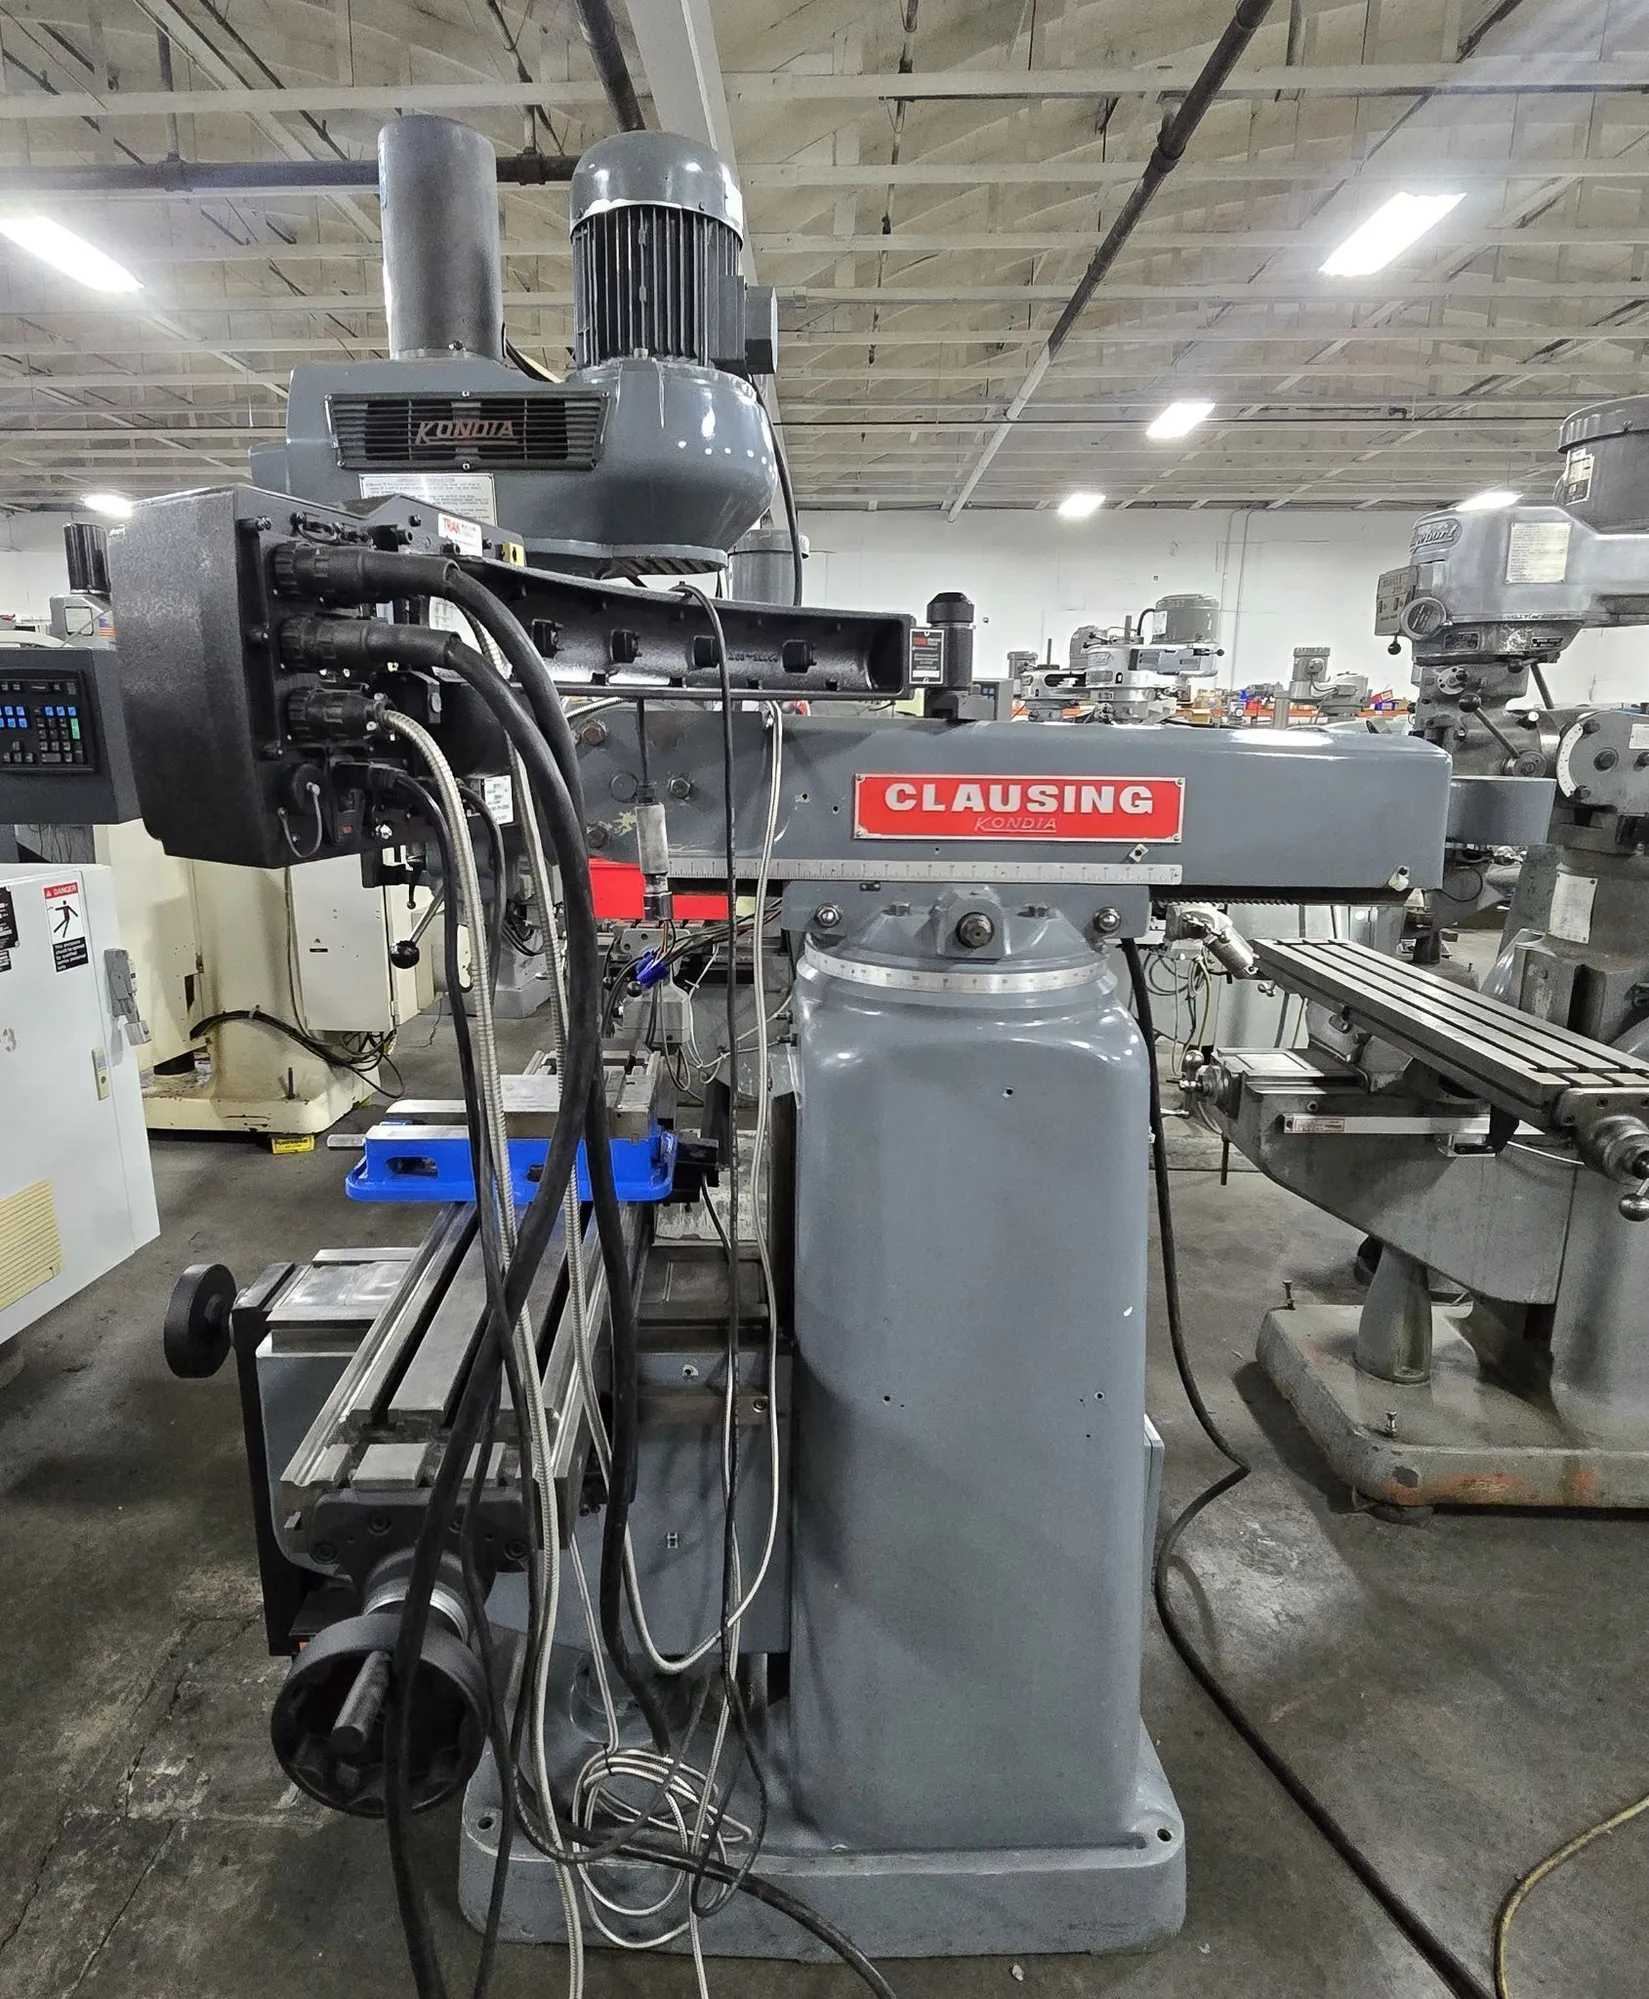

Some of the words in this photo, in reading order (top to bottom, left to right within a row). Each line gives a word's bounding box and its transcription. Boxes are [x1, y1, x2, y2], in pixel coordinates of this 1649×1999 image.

[415, 419, 515, 446] KONDIA
[884, 783, 1153, 815] CLAUSING
[974, 816, 1056, 833] KONDIA
[53, 884, 77, 896] DANGER
